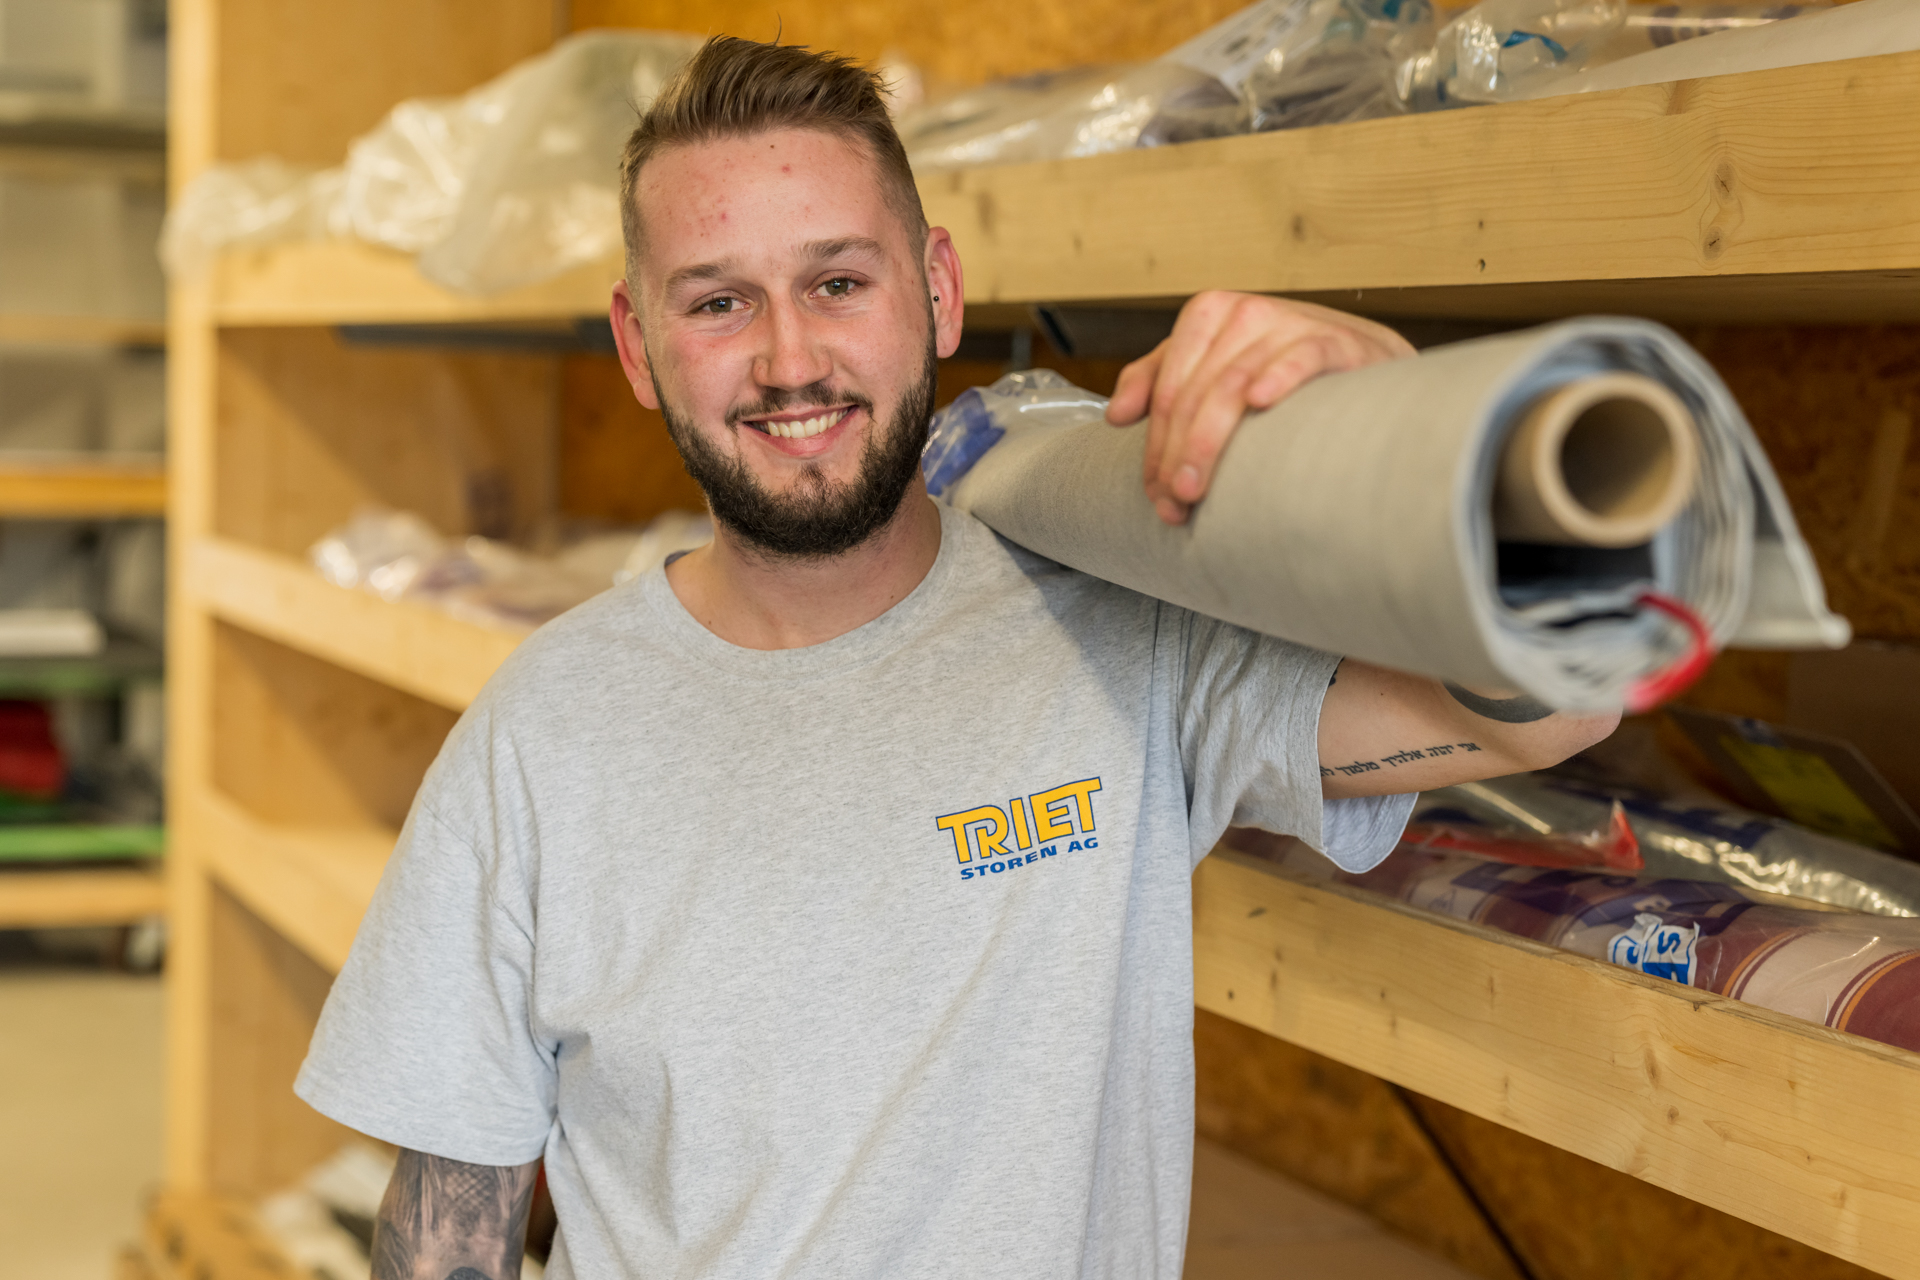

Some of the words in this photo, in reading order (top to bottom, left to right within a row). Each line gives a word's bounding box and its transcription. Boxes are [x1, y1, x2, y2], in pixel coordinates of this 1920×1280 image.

[935, 776, 1103, 864] TRIET
[960, 845, 1057, 880] STOREN
[1067, 837, 1099, 853] AG
